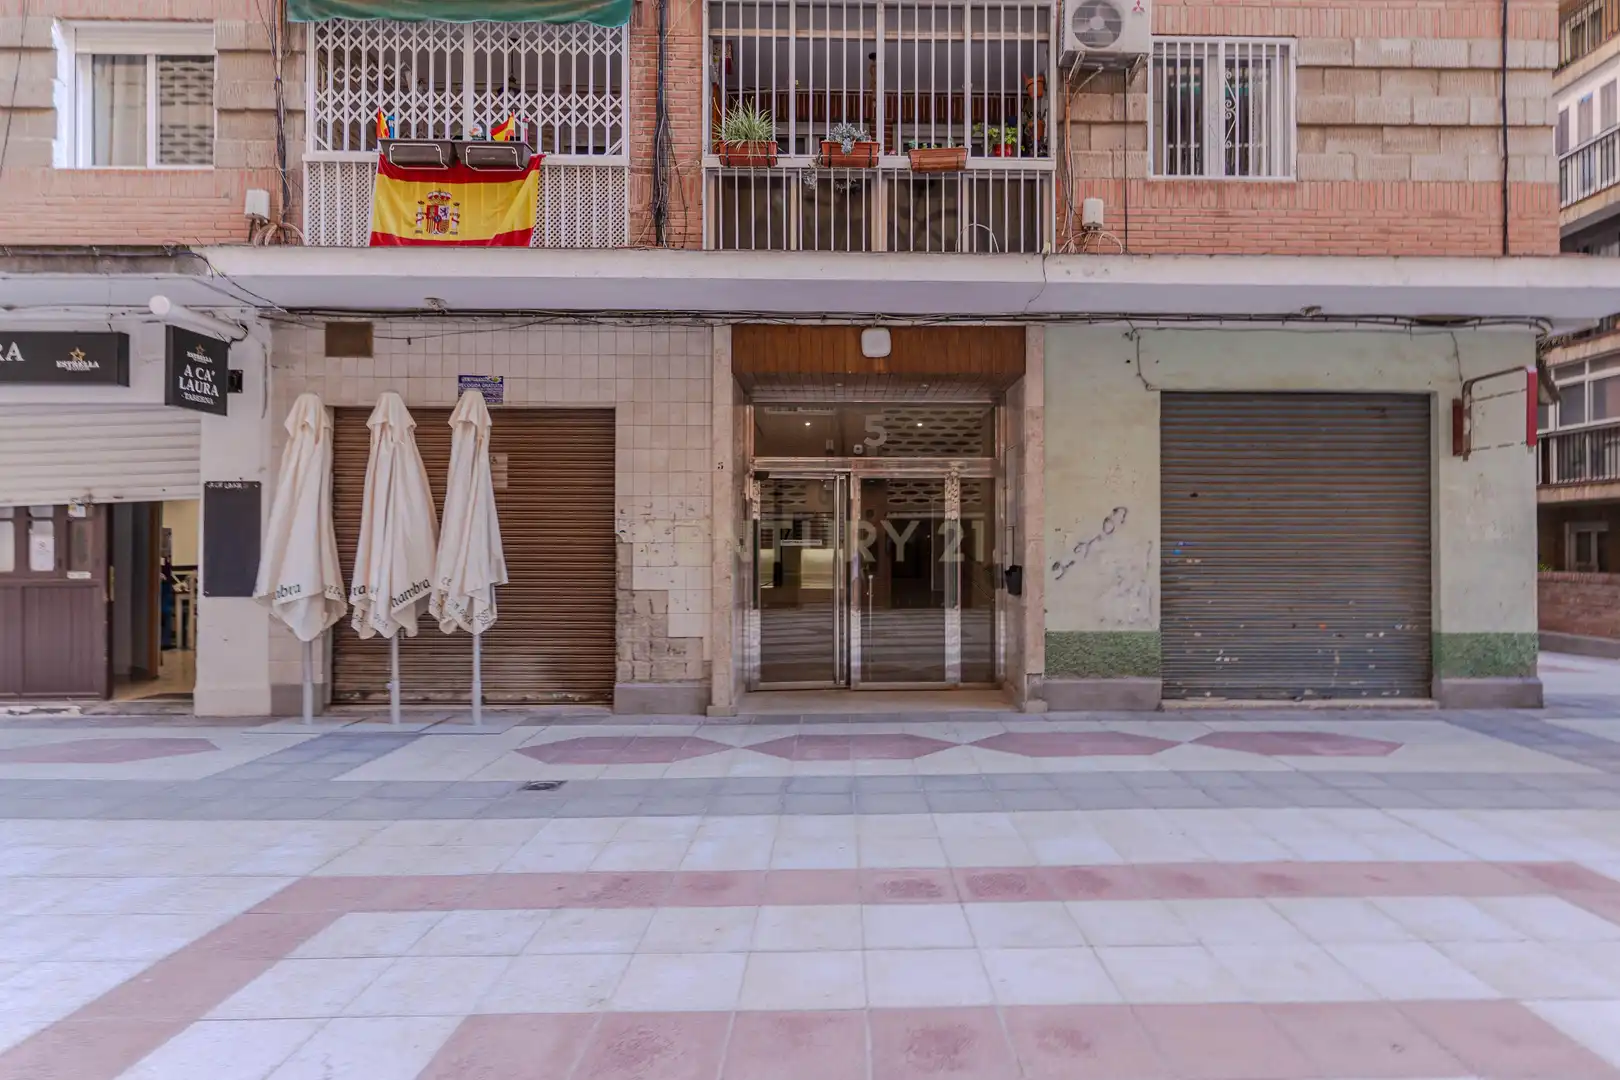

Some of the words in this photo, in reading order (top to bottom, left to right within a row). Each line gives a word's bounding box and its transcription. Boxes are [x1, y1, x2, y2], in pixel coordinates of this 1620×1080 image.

[184, 364, 193, 378] A
[179, 375, 219, 397] LAURA
[864, 415, 887, 446] 5
